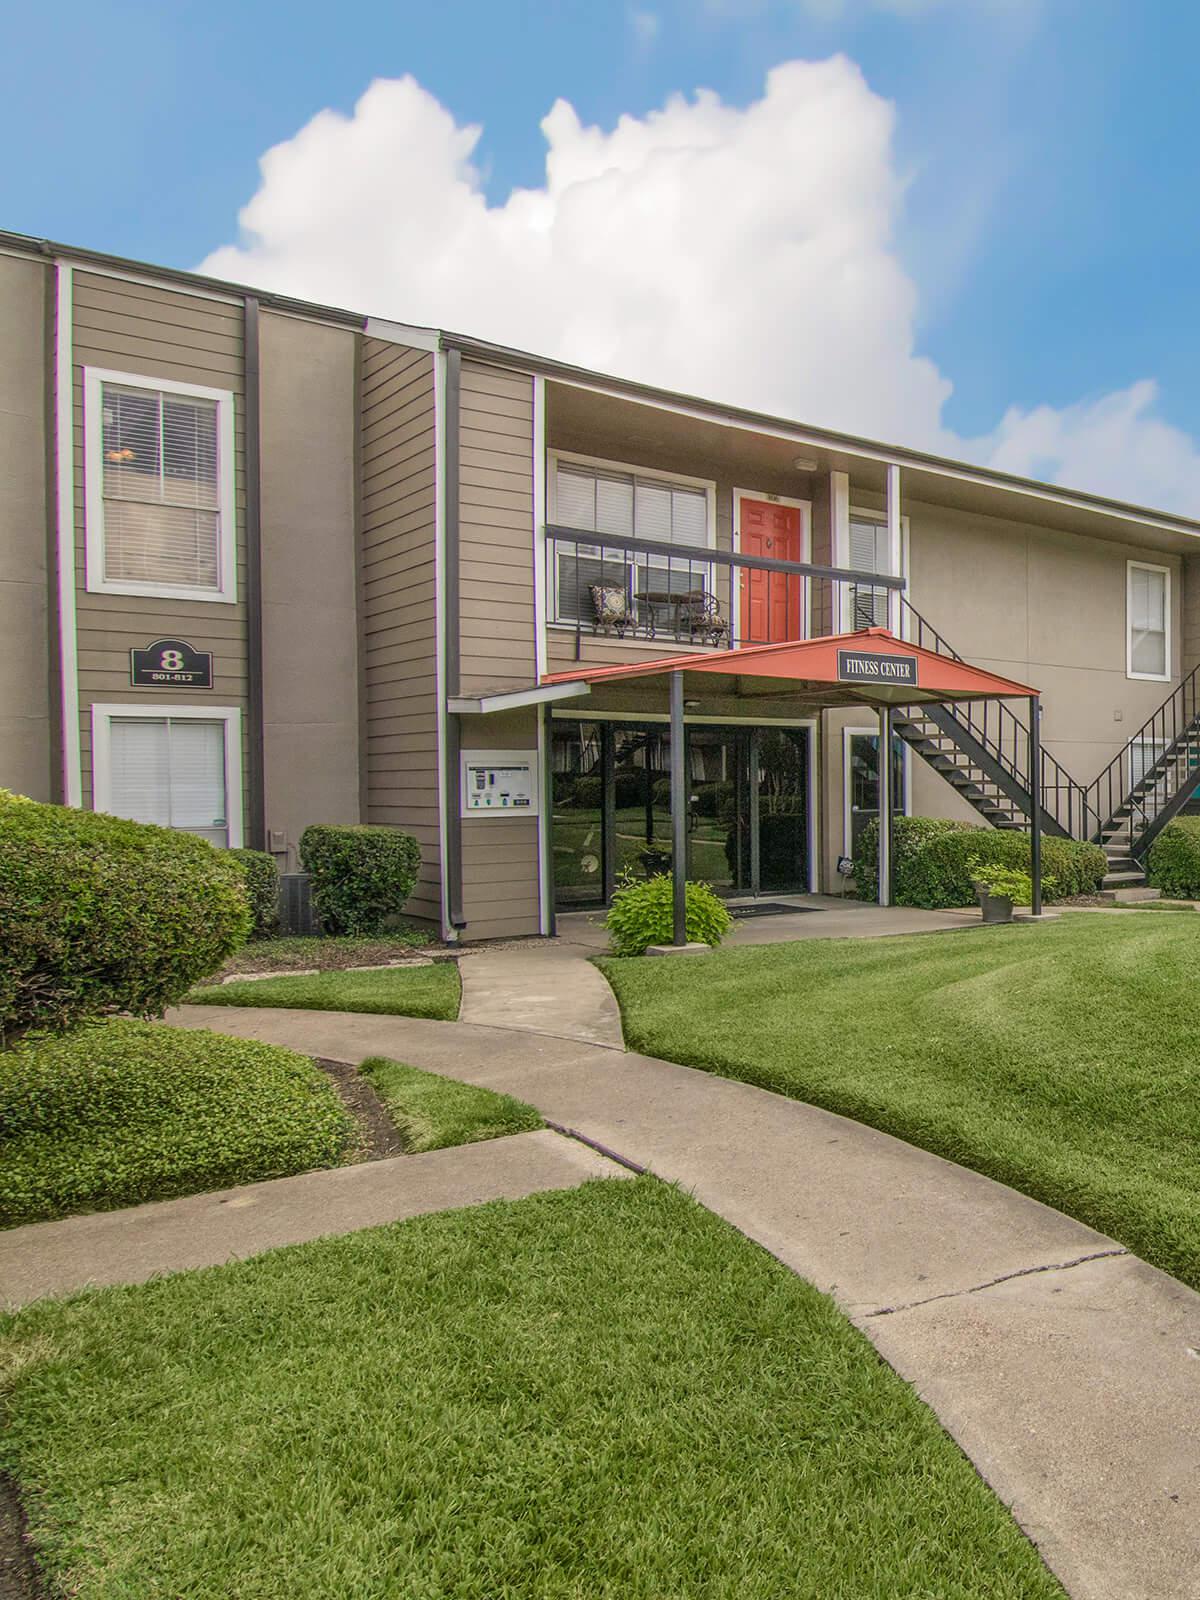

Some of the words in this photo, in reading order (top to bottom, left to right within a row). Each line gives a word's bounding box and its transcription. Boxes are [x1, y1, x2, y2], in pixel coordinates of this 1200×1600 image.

[160, 650, 184, 671] 8
[846, 658, 879, 675] FITNESS
[880, 662, 911, 678] CENTER
[152, 673, 193, 682] 801-812
